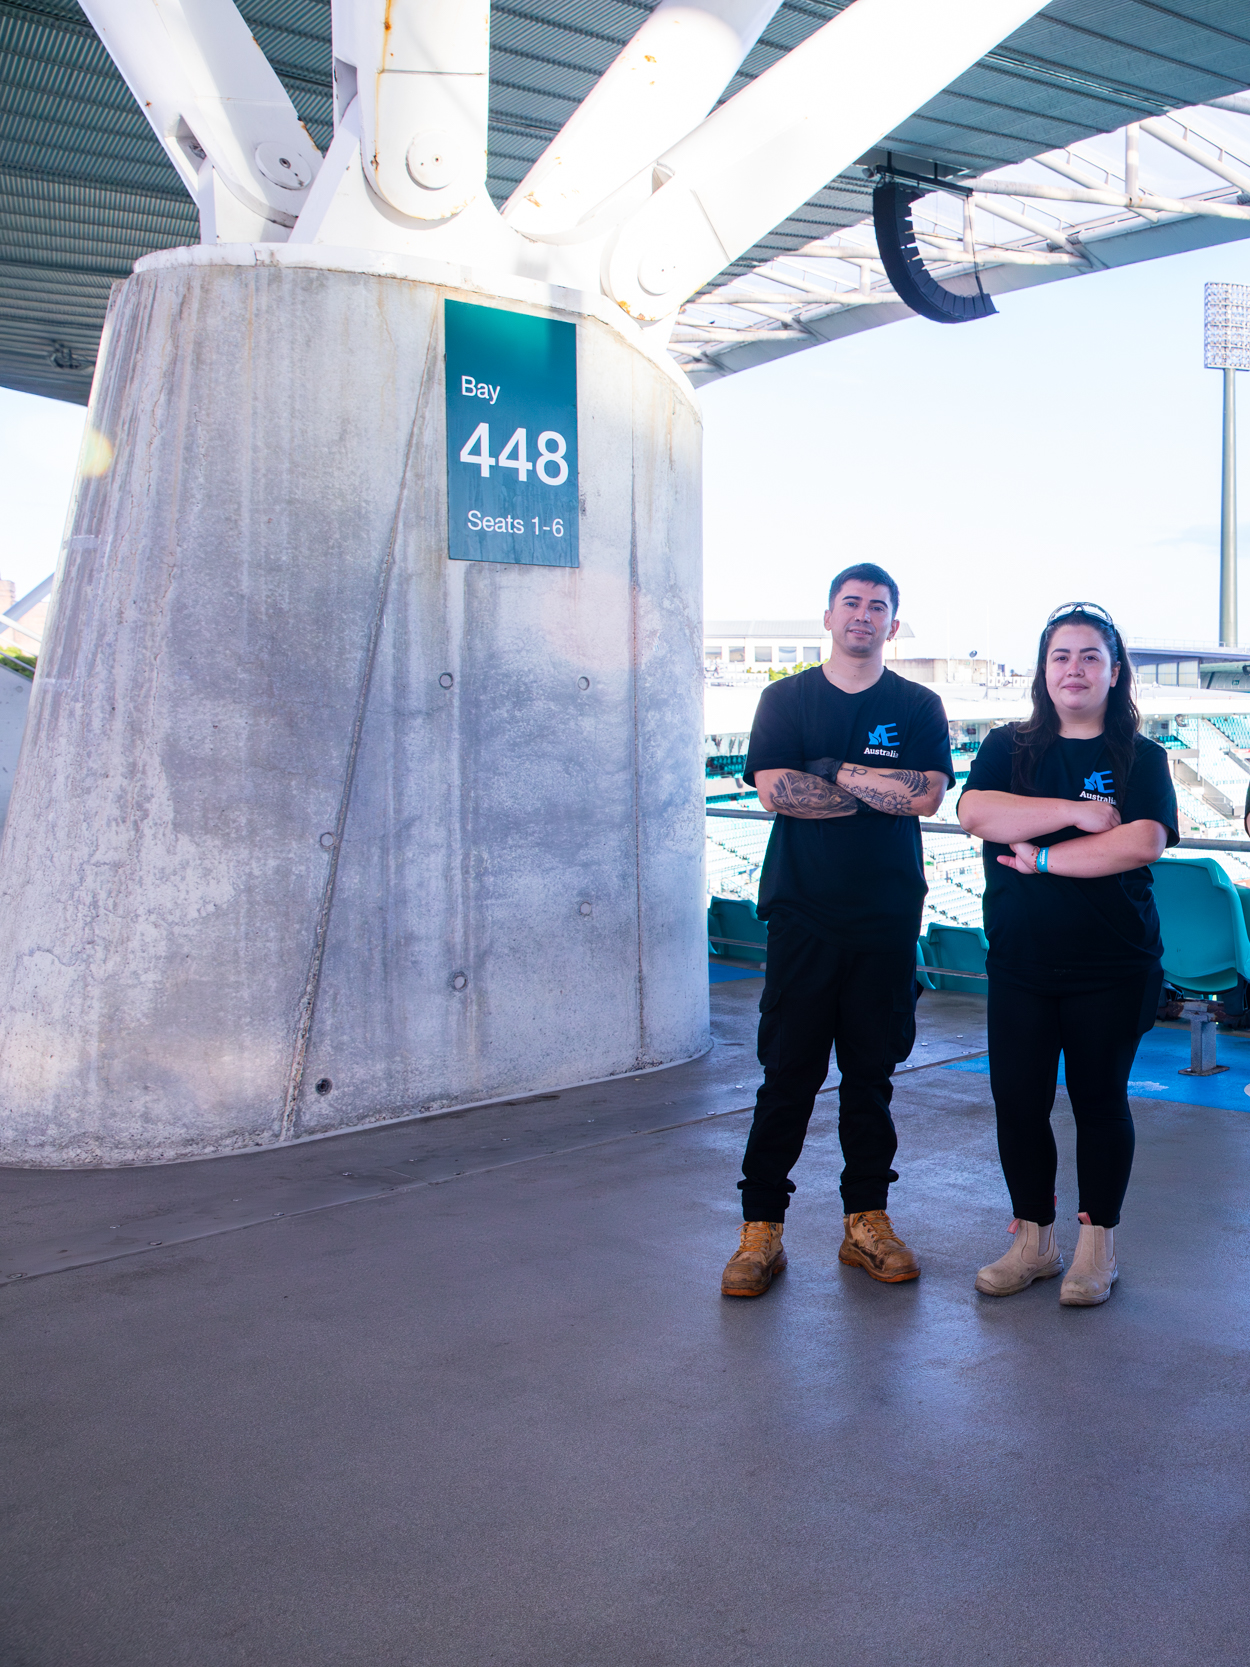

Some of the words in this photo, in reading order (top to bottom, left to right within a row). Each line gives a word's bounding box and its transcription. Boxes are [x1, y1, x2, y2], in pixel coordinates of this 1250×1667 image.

[461, 375, 500, 405] Bay
[460, 422, 569, 486] 448
[467, 510, 525, 534] Seats
[531, 516, 564, 538] 1-6
[863, 747, 899, 759] Australia
